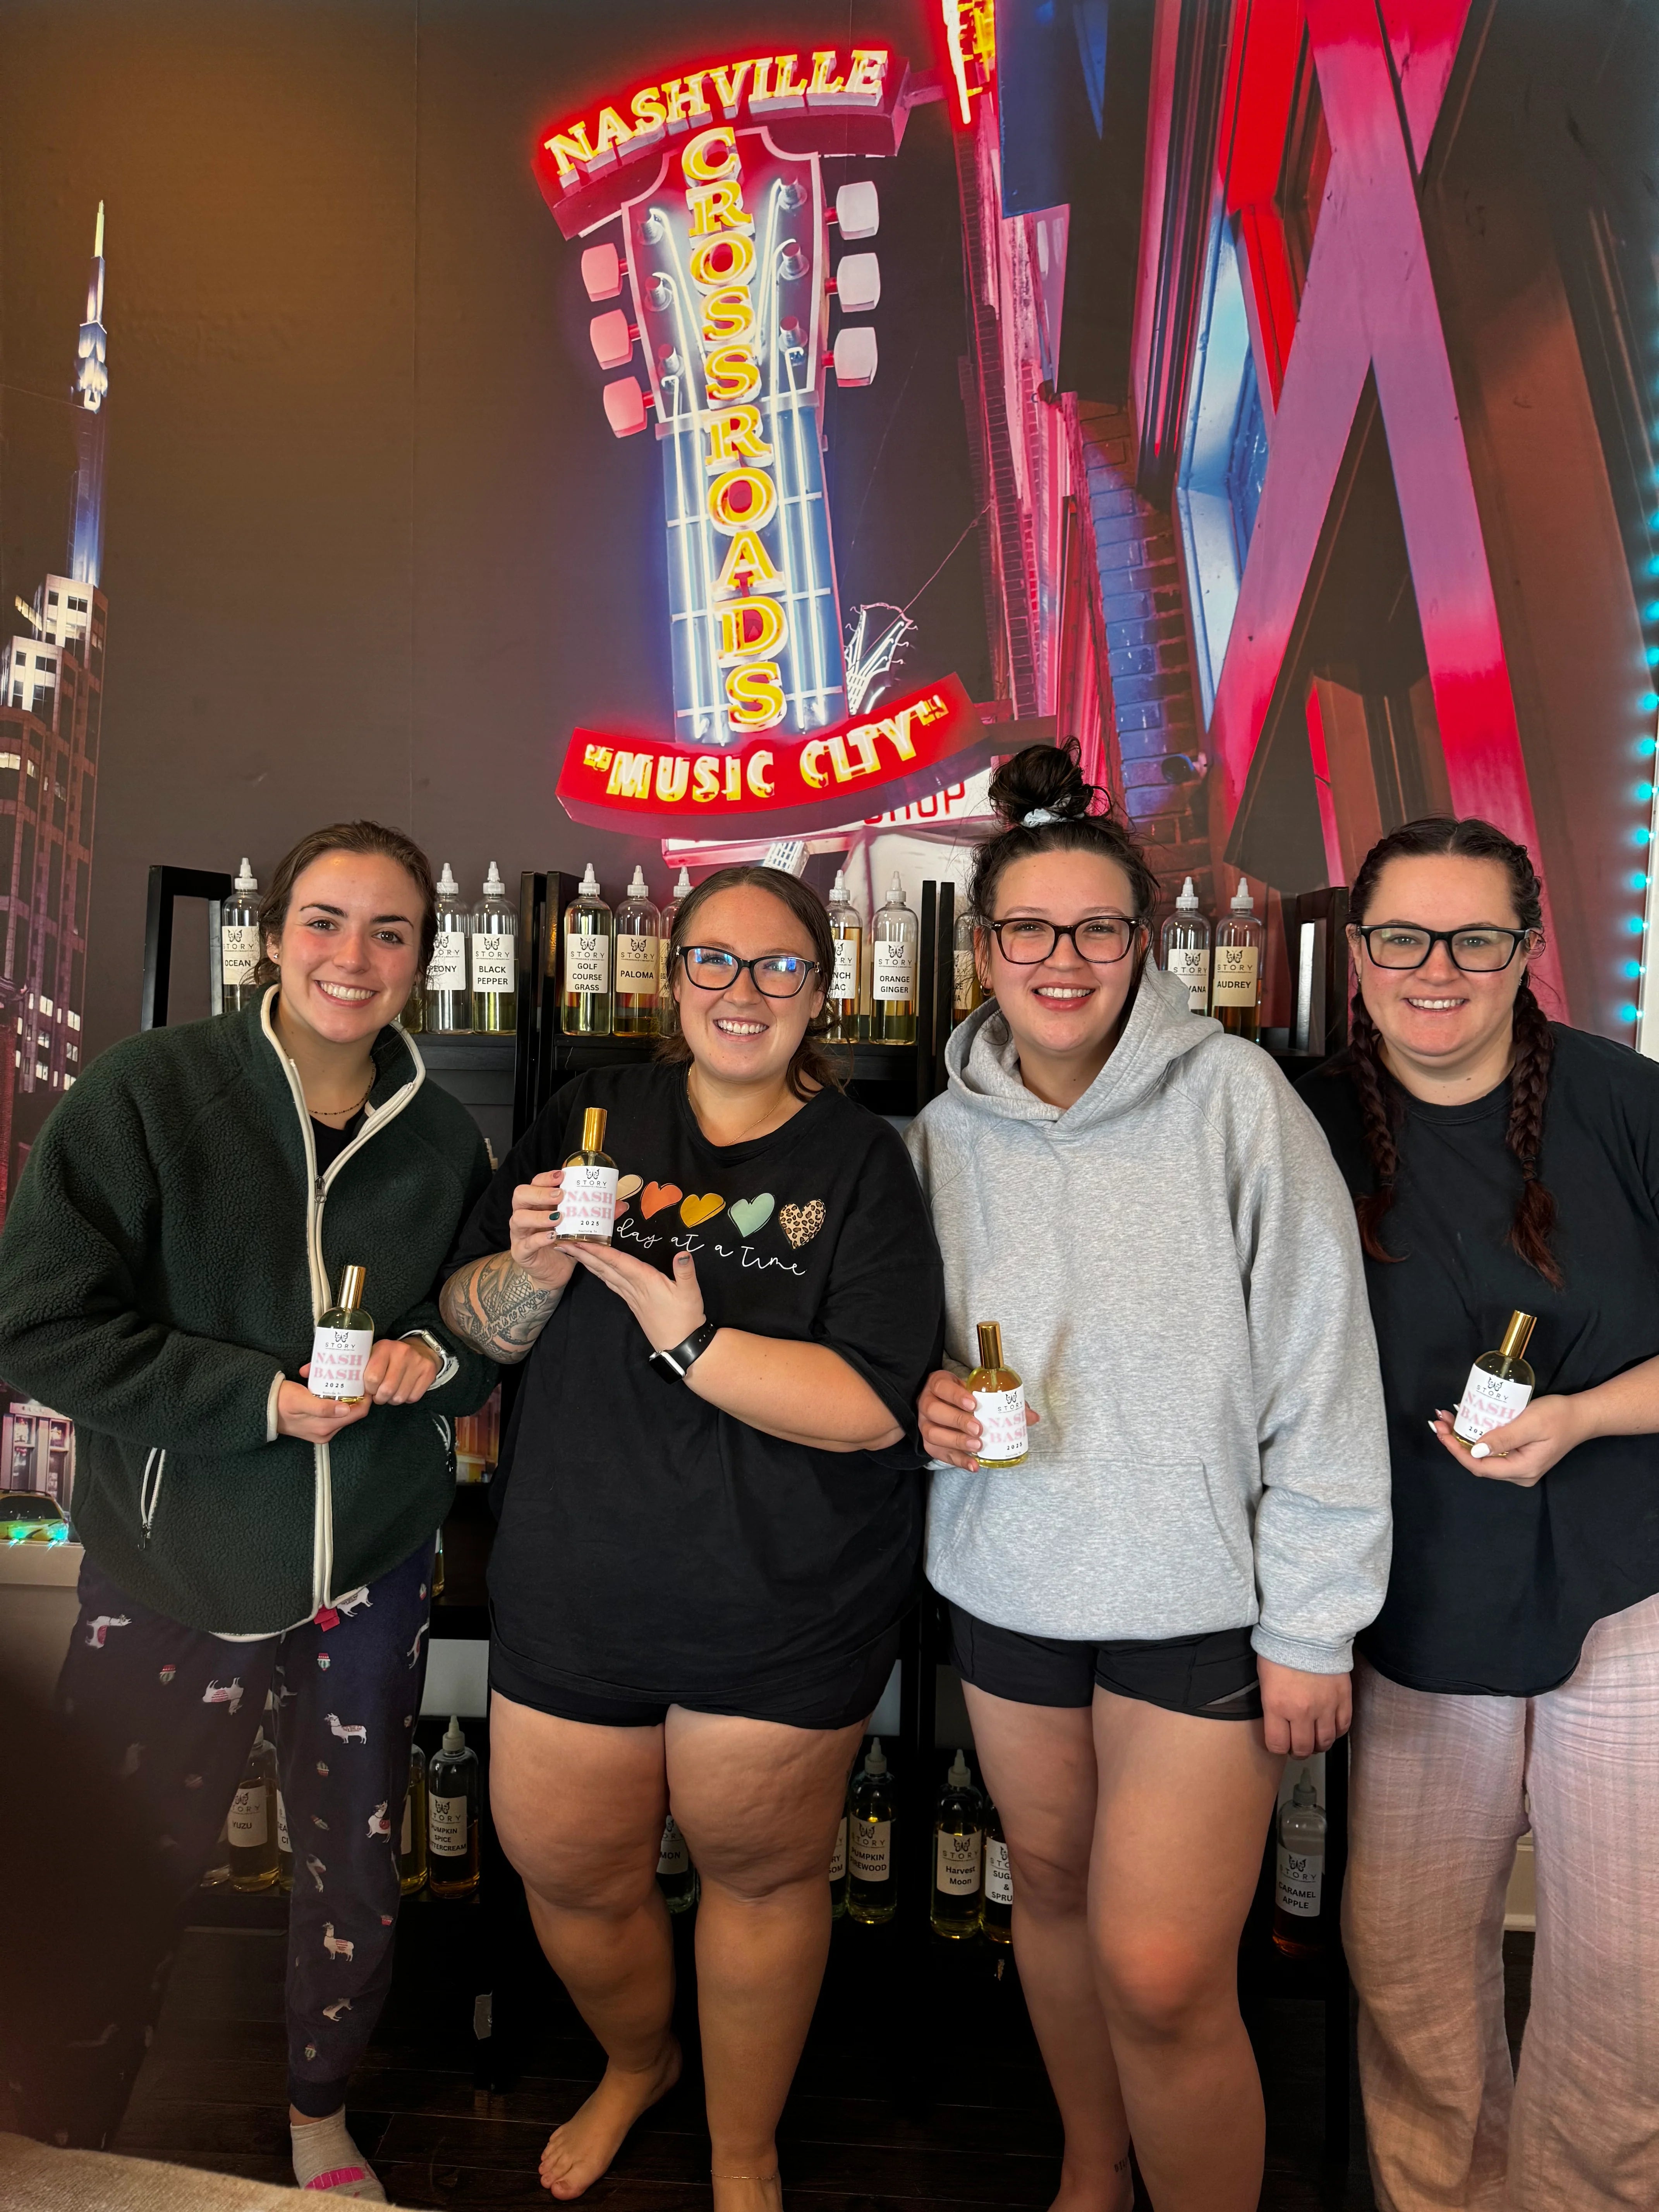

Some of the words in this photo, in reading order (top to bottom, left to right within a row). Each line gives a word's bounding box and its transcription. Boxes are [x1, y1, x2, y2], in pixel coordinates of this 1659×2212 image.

[544, 50, 888, 177] NASHVILLE
[681, 127, 788, 725] CROSSROADS
[621, 970, 654, 979] PALOMA
[567, 1190, 613, 1204] NASH
[566, 1206, 612, 1219] BASH
[617, 1218, 663, 1249] day
[715, 1244, 734, 1257] a
[316, 1352, 363, 1366] NASH
[314, 1367, 361, 1381] BASH
[1477, 1385, 1509, 1400] STORY
[998, 1401, 1023, 1412] STORY
[1465, 1390, 1515, 1419] NASH
[1469, 1426, 1483, 1436] 202
[1007, 1442, 1022, 1450] 2025
[232, 1820, 252, 1829] YUZU
[434, 1834, 452, 1843] SPICE
[942, 1850, 979, 1859] STORY
[990, 1857, 1010, 1868] STO
[946, 1865, 975, 1874] Harvest
[993, 1870, 1011, 1879] SUG
[1279, 1881, 1316, 1898] CARAMEL
[992, 1891, 1013, 1901] SPRU
[1283, 1896, 1309, 1909] APPLE
